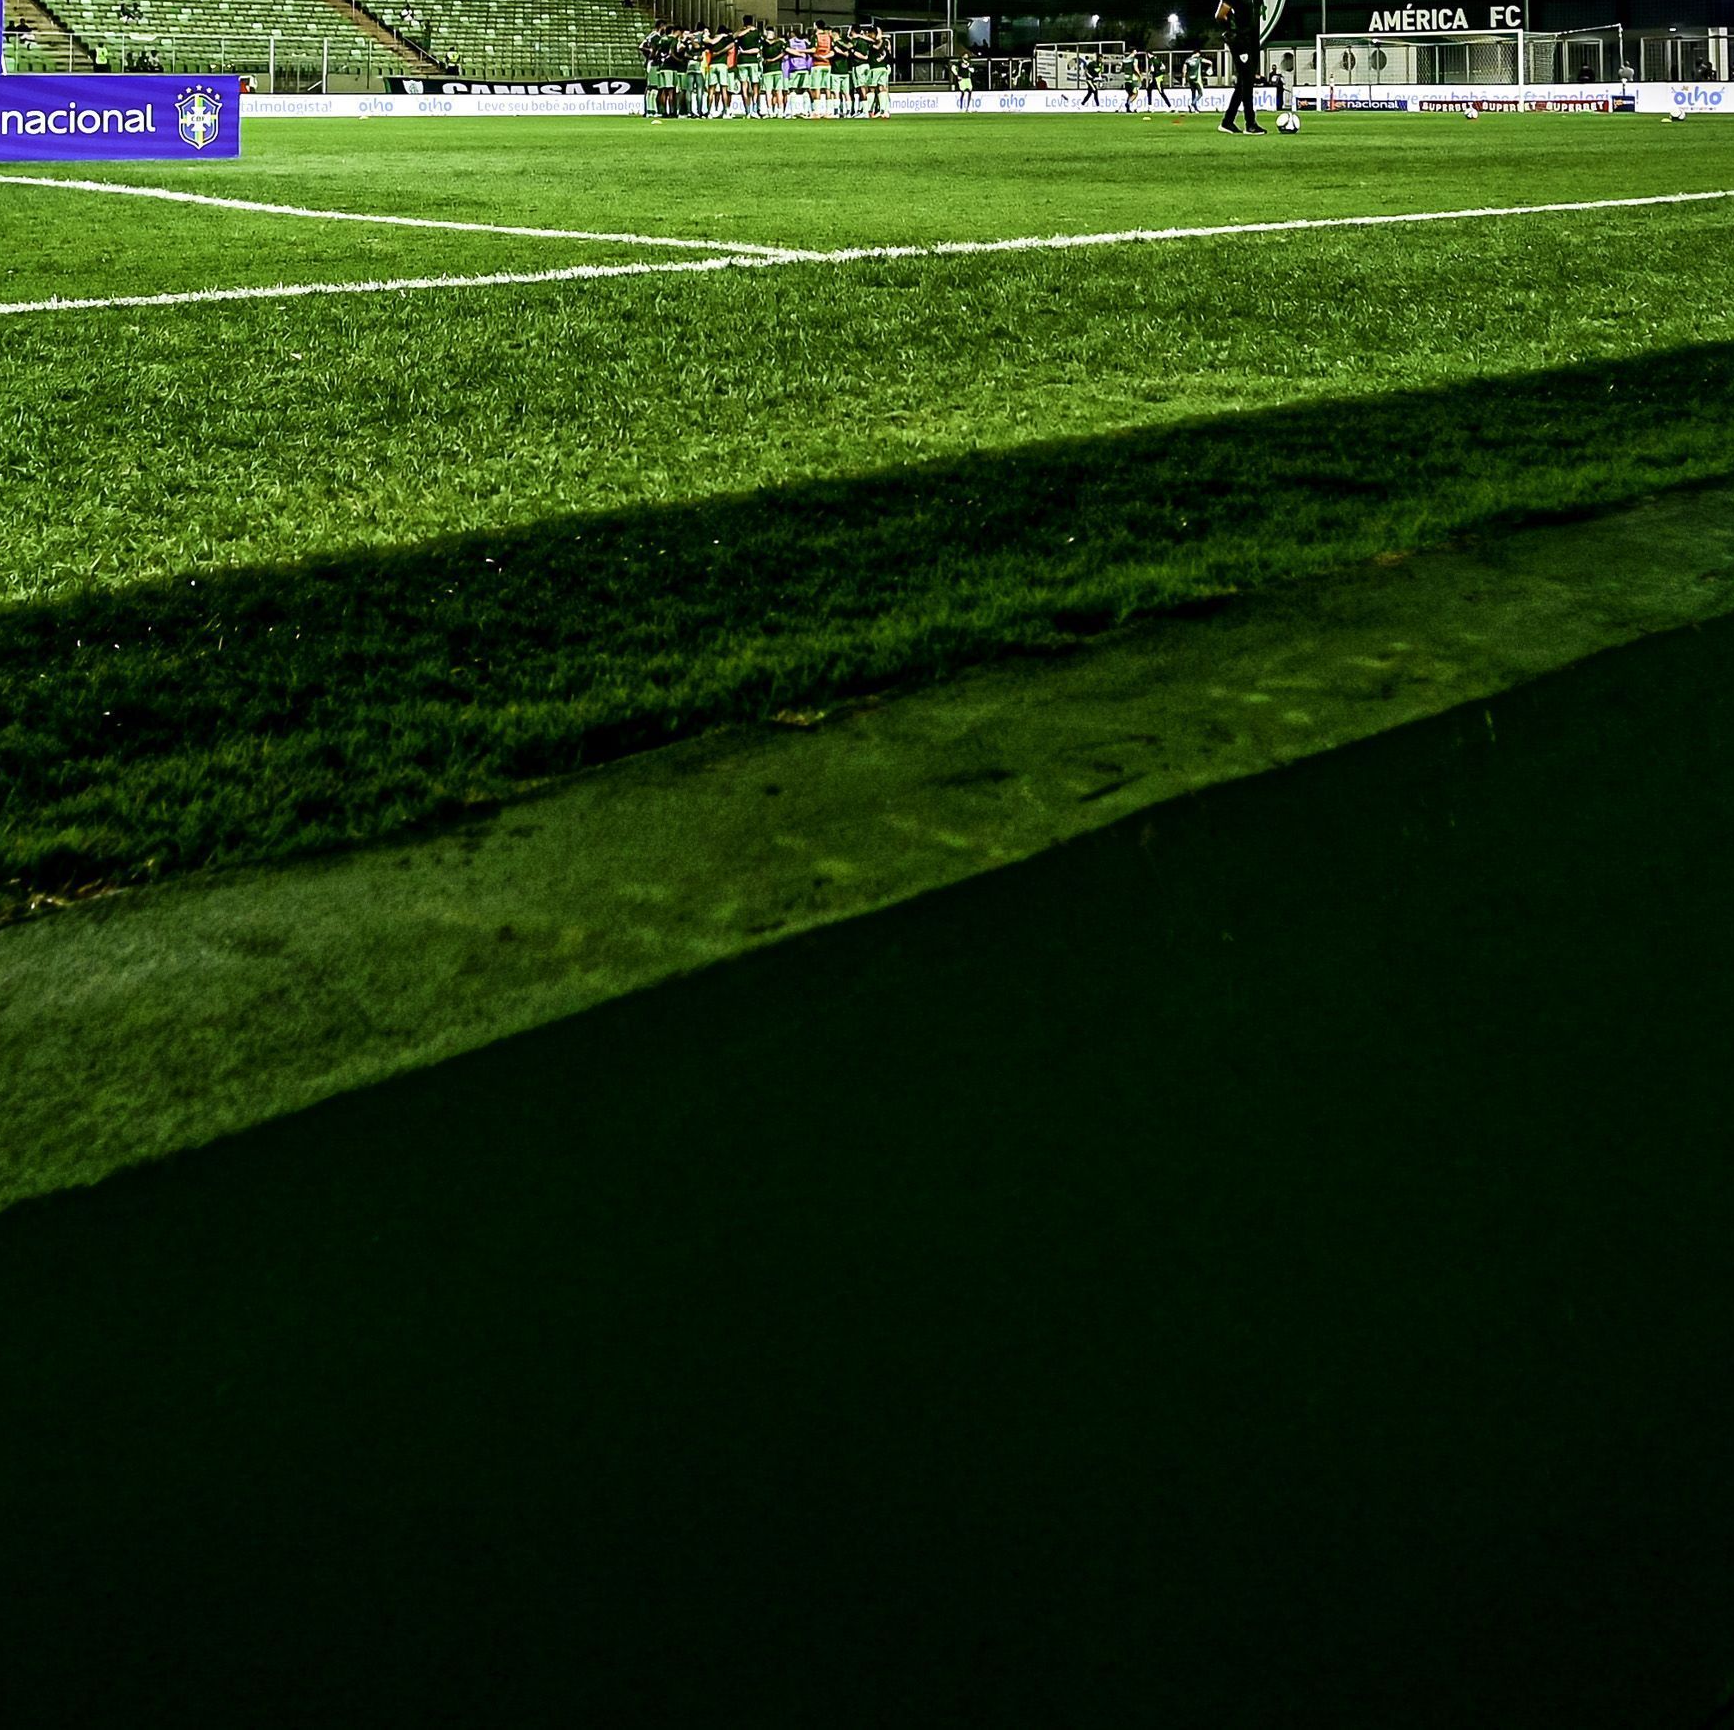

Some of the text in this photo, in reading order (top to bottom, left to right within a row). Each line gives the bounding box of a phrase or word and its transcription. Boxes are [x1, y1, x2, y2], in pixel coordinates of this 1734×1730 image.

[1368, 3, 1522, 32] AMÉRICA FC
[441, 81, 631, 95] CAMISA 12
[240, 100, 332, 115] talmologista!
[477, 100, 505, 112] Leve
[508, 102, 529, 112] seu
[531, 99, 560, 112] bebê
[562, 102, 577, 112] ao
[1546, 101, 1605, 112] SUPERBET
